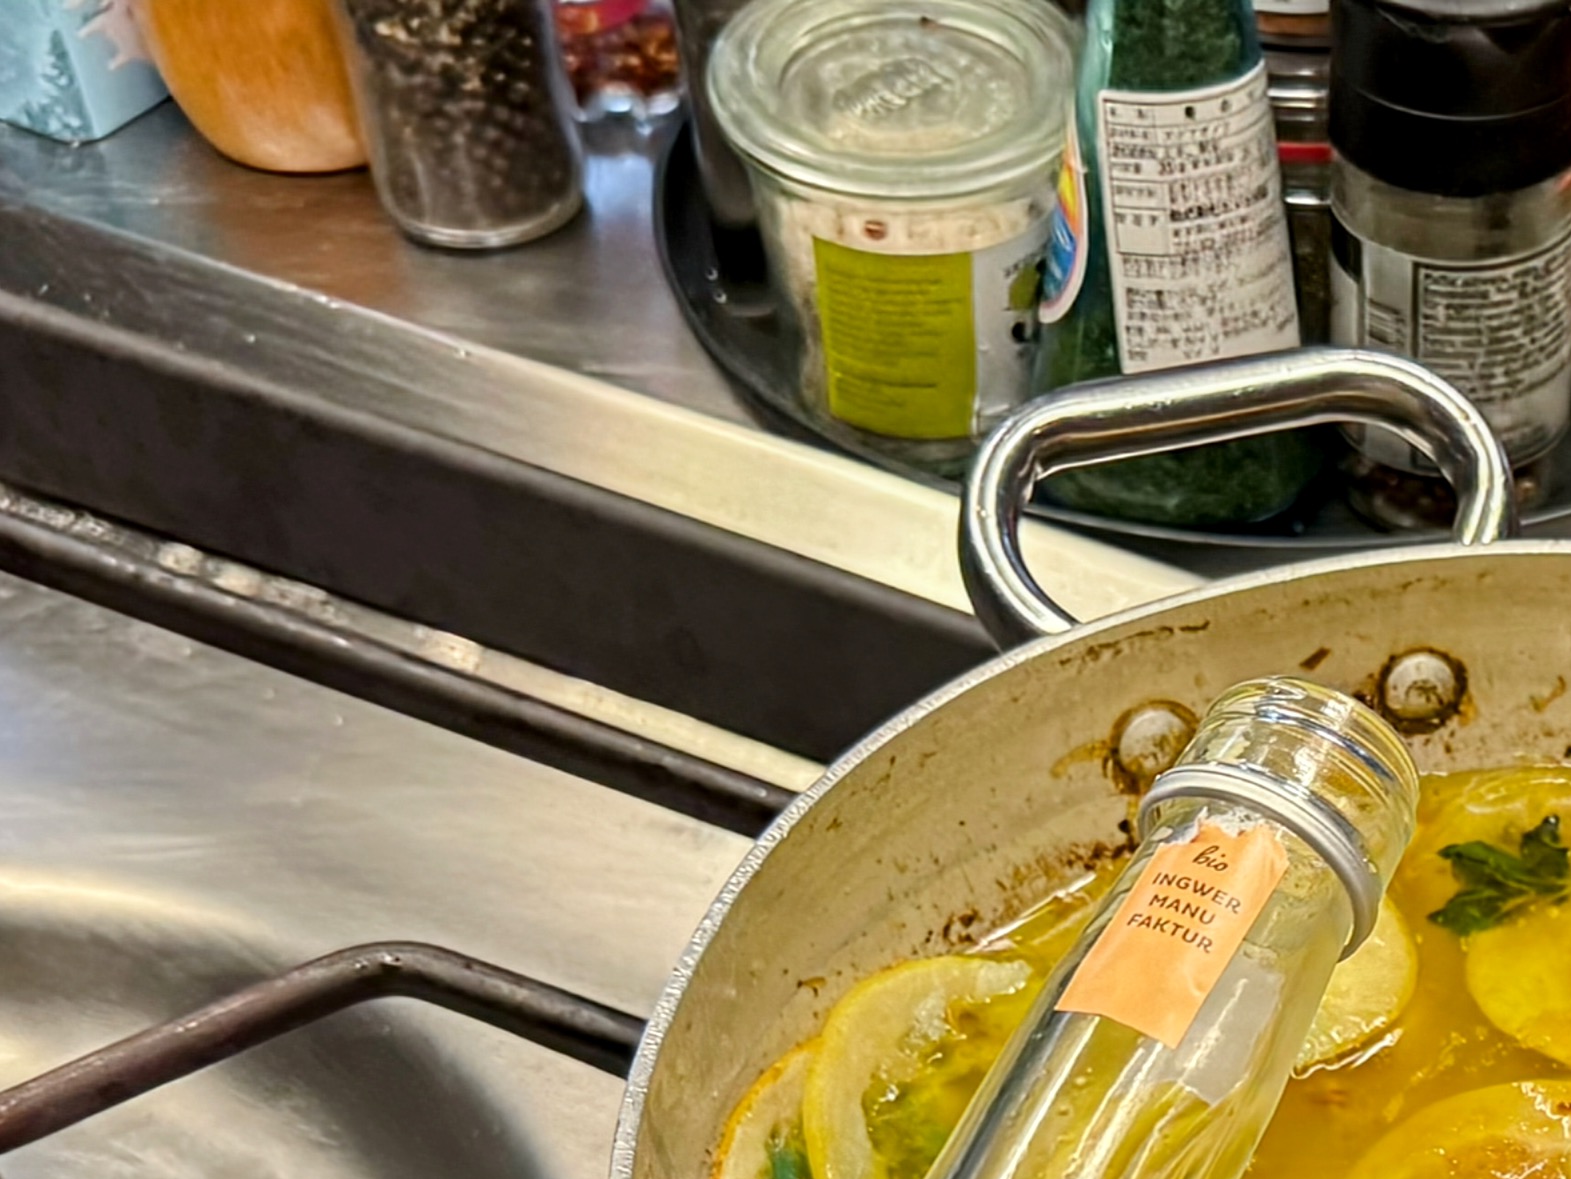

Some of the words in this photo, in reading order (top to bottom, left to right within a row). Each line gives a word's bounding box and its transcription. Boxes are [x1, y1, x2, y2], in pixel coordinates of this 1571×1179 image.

[1192, 845, 1229, 872] bio
[1148, 894, 1216, 925] MANU
[1151, 872, 1242, 915] INGWER
[1126, 913, 1213, 954] FAKTUR
